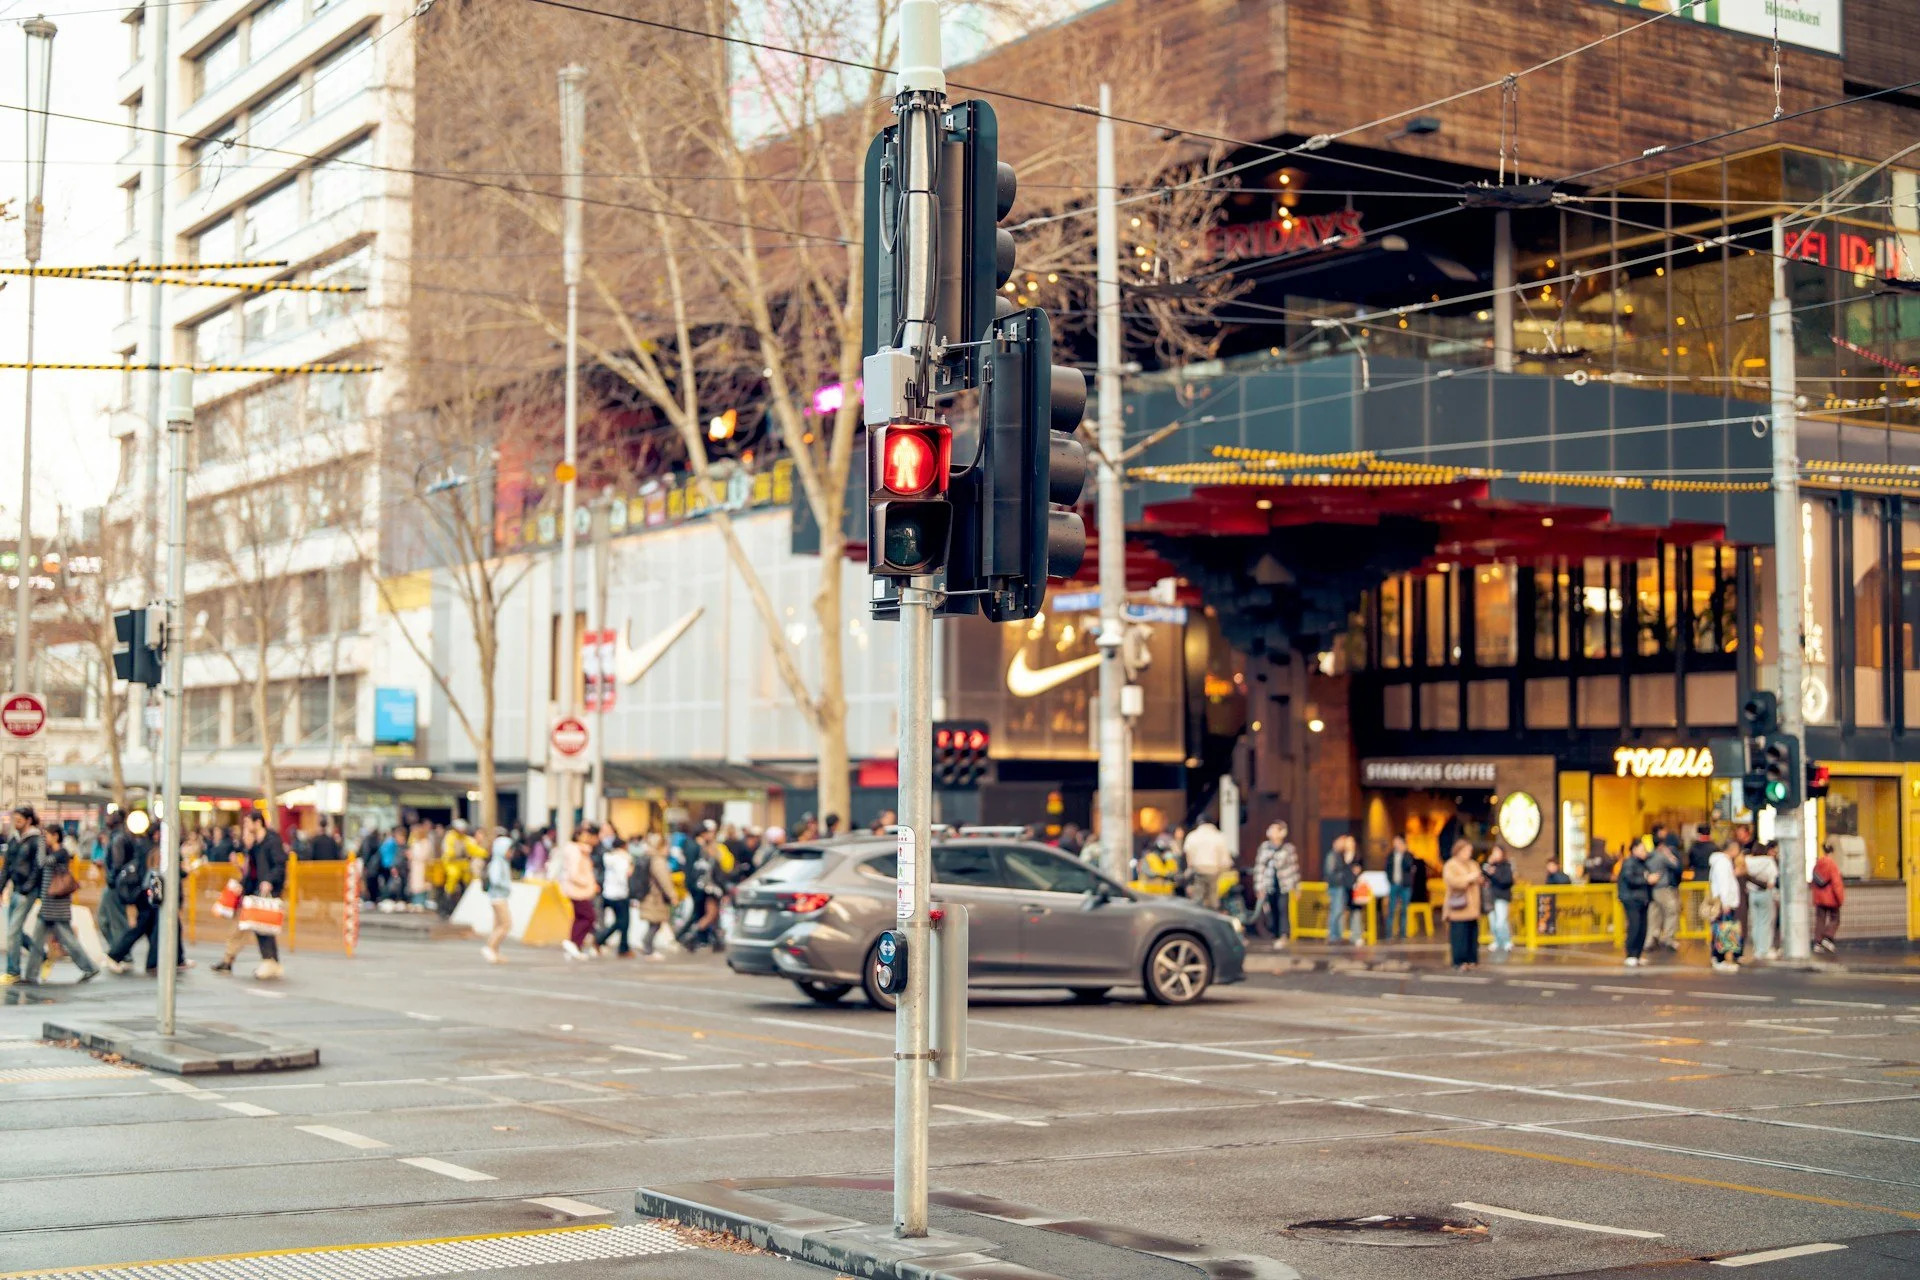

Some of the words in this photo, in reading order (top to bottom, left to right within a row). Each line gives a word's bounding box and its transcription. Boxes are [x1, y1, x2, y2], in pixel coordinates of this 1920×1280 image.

[1765, 0, 1820, 26] Heineken
[1366, 763, 1442, 781] STARBUCKS
[1444, 763, 1496, 781] COFFEE
